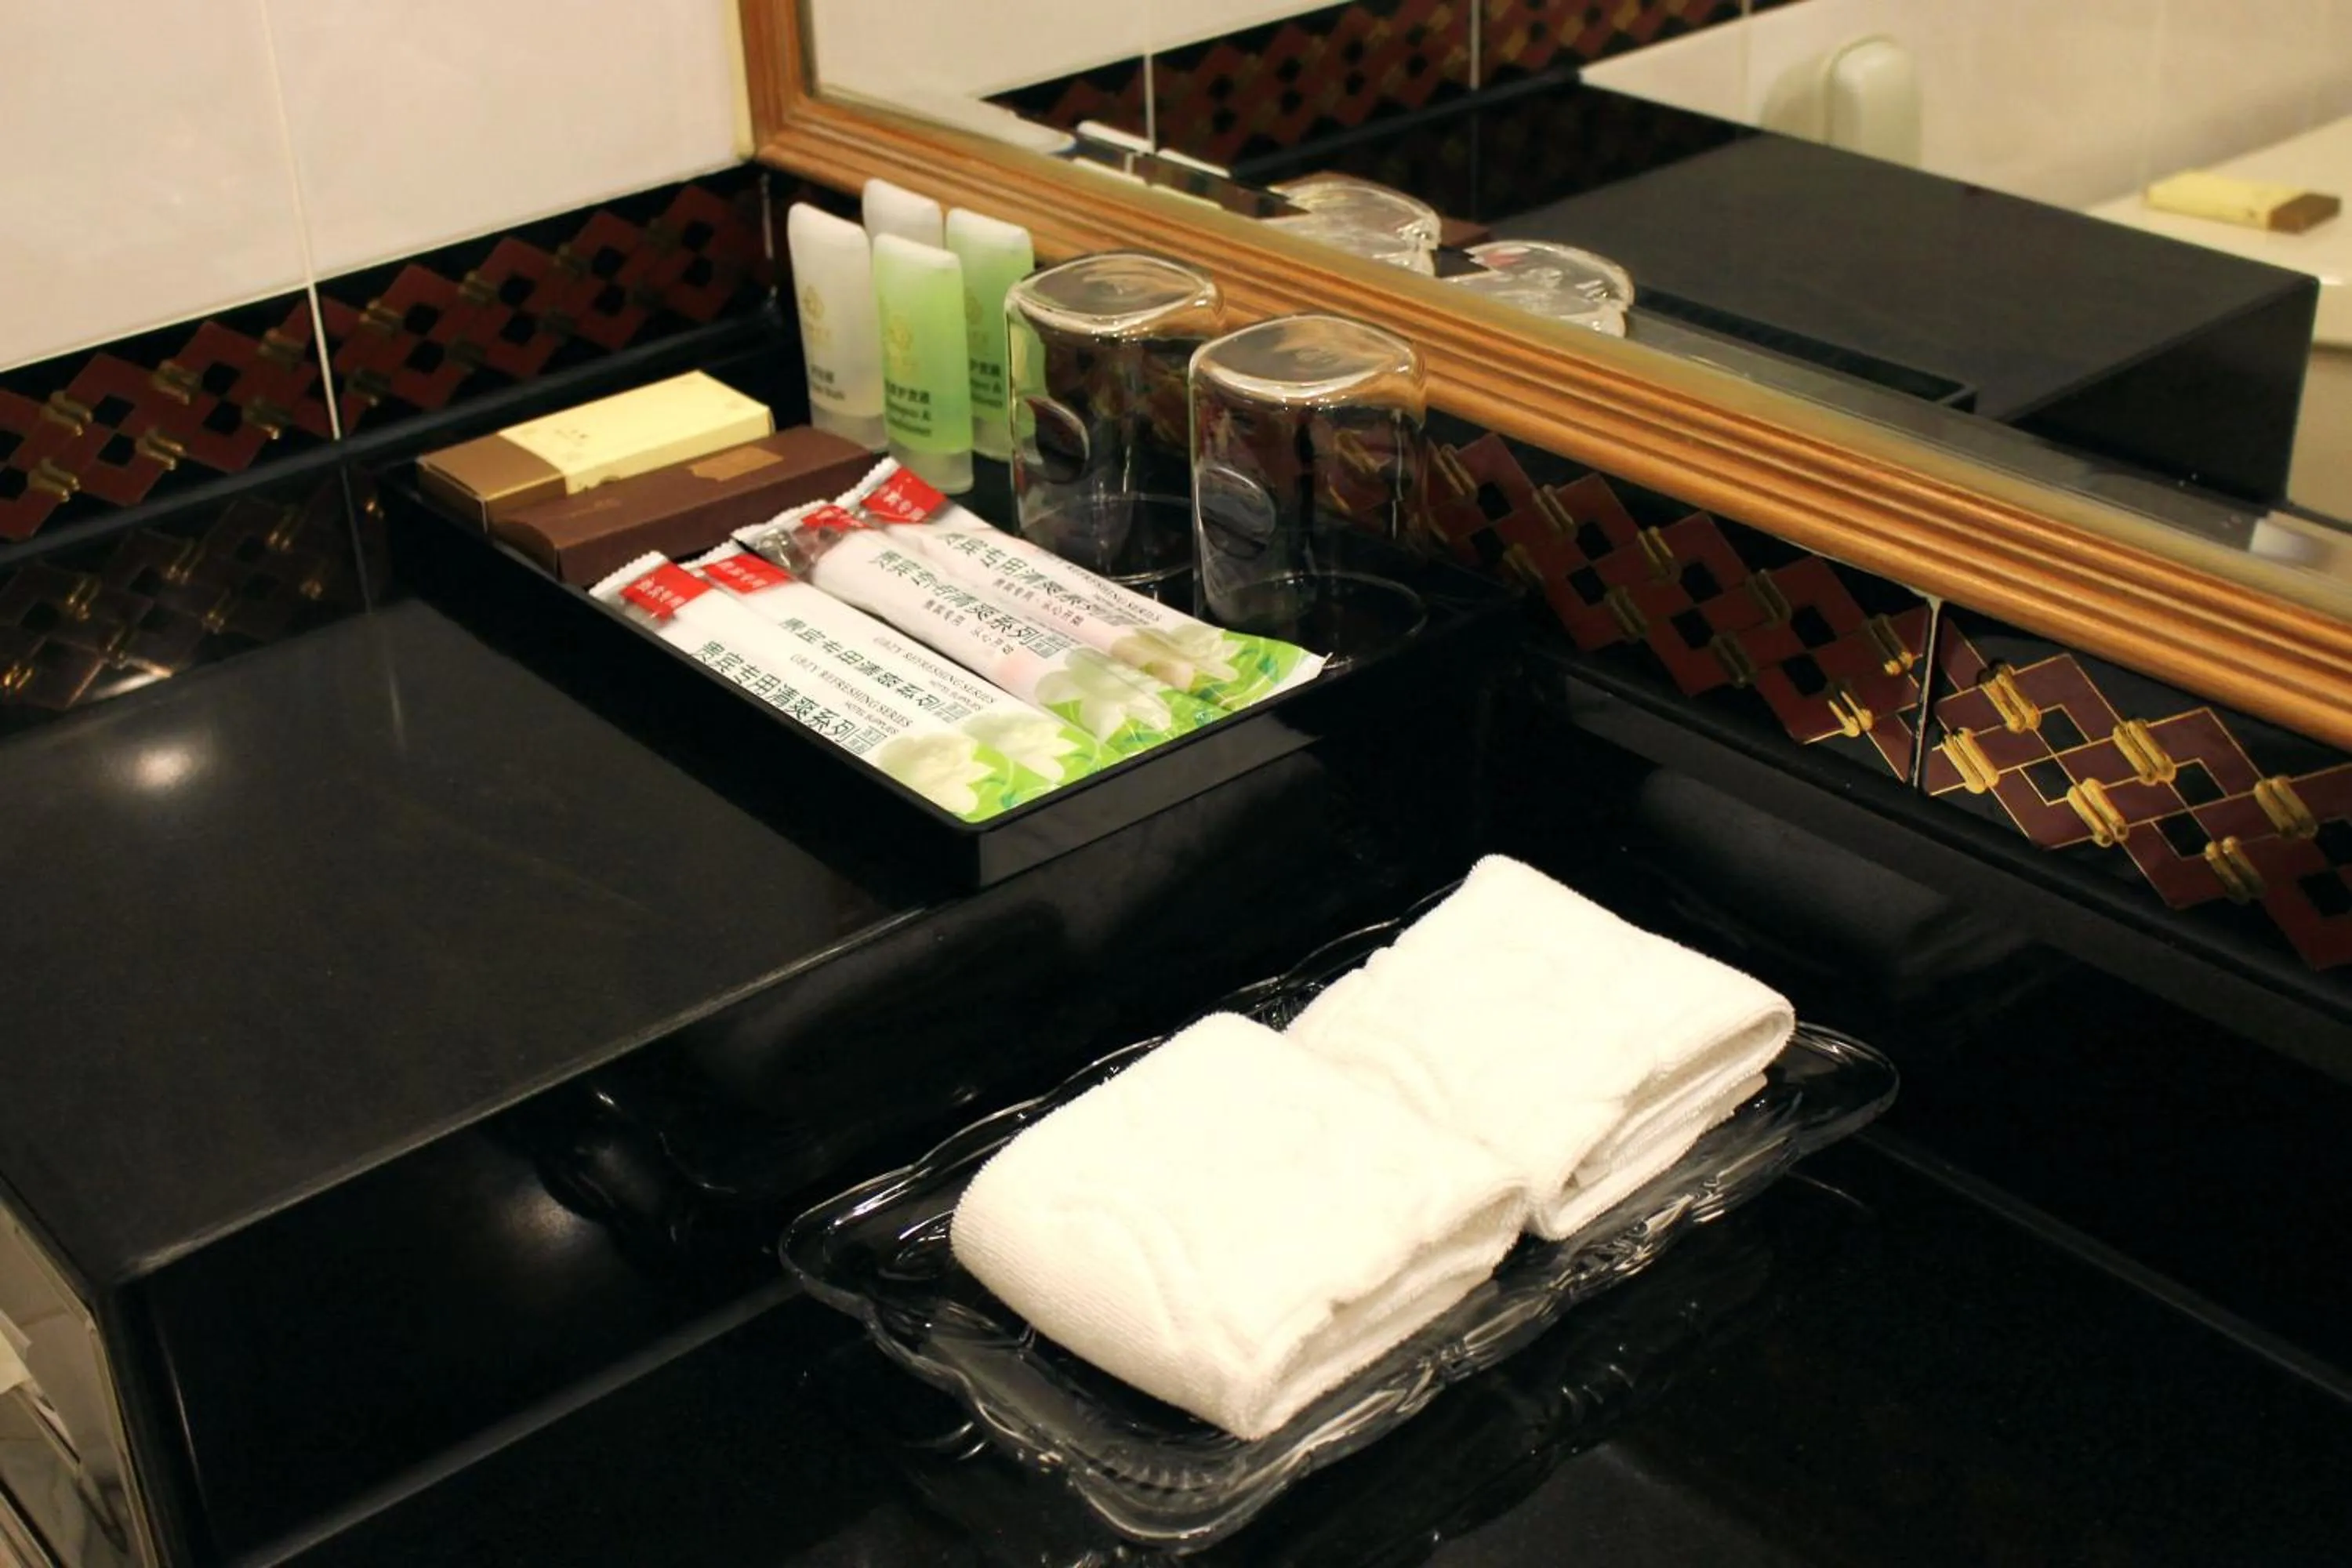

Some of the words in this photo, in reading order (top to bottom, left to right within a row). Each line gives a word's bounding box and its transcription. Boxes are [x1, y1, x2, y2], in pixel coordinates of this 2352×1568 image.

[691, 640, 861, 743] 贵宾专用清爽系列
[818, 666, 881, 710] REFRESHING
[876, 702, 913, 728] SERIES
